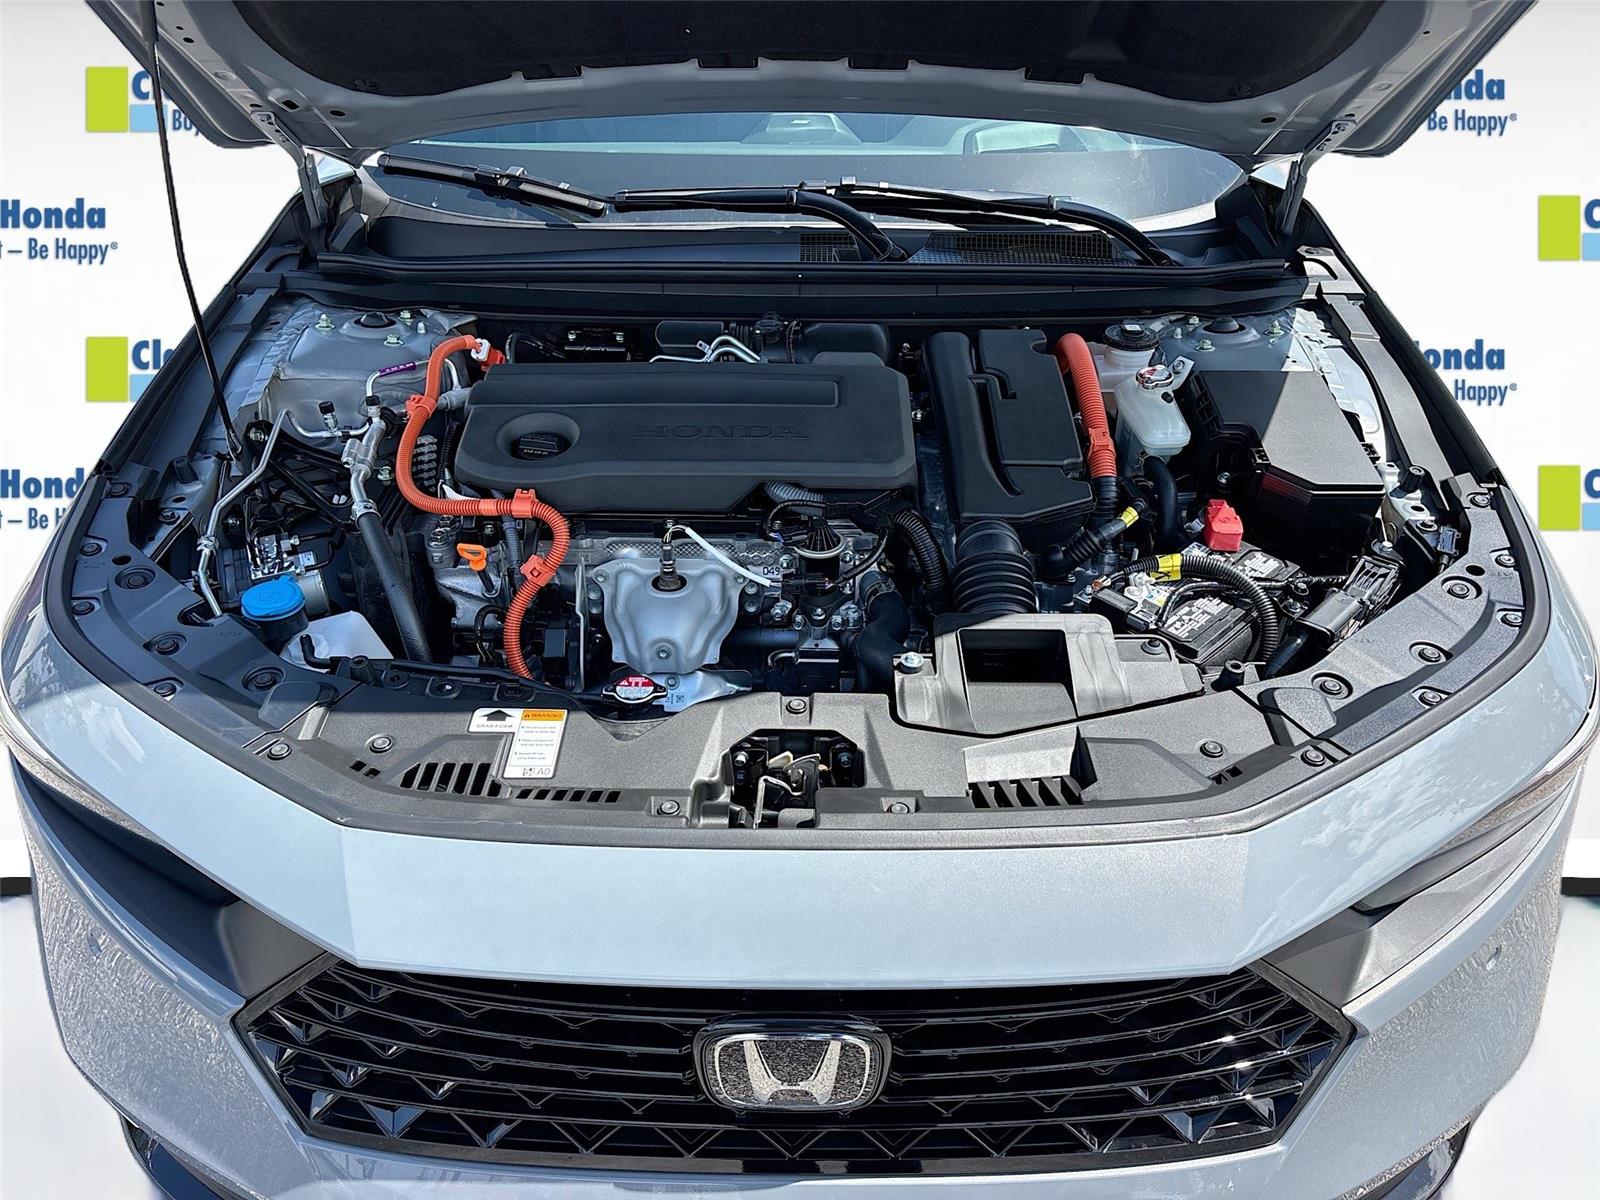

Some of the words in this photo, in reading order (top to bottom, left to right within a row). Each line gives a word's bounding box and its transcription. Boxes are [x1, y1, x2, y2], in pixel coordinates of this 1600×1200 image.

[0, 197, 106, 229] Honda
[28, 238, 49, 260] Be
[631, 423, 814, 440] HONDA
[28, 507, 49, 529] Be
